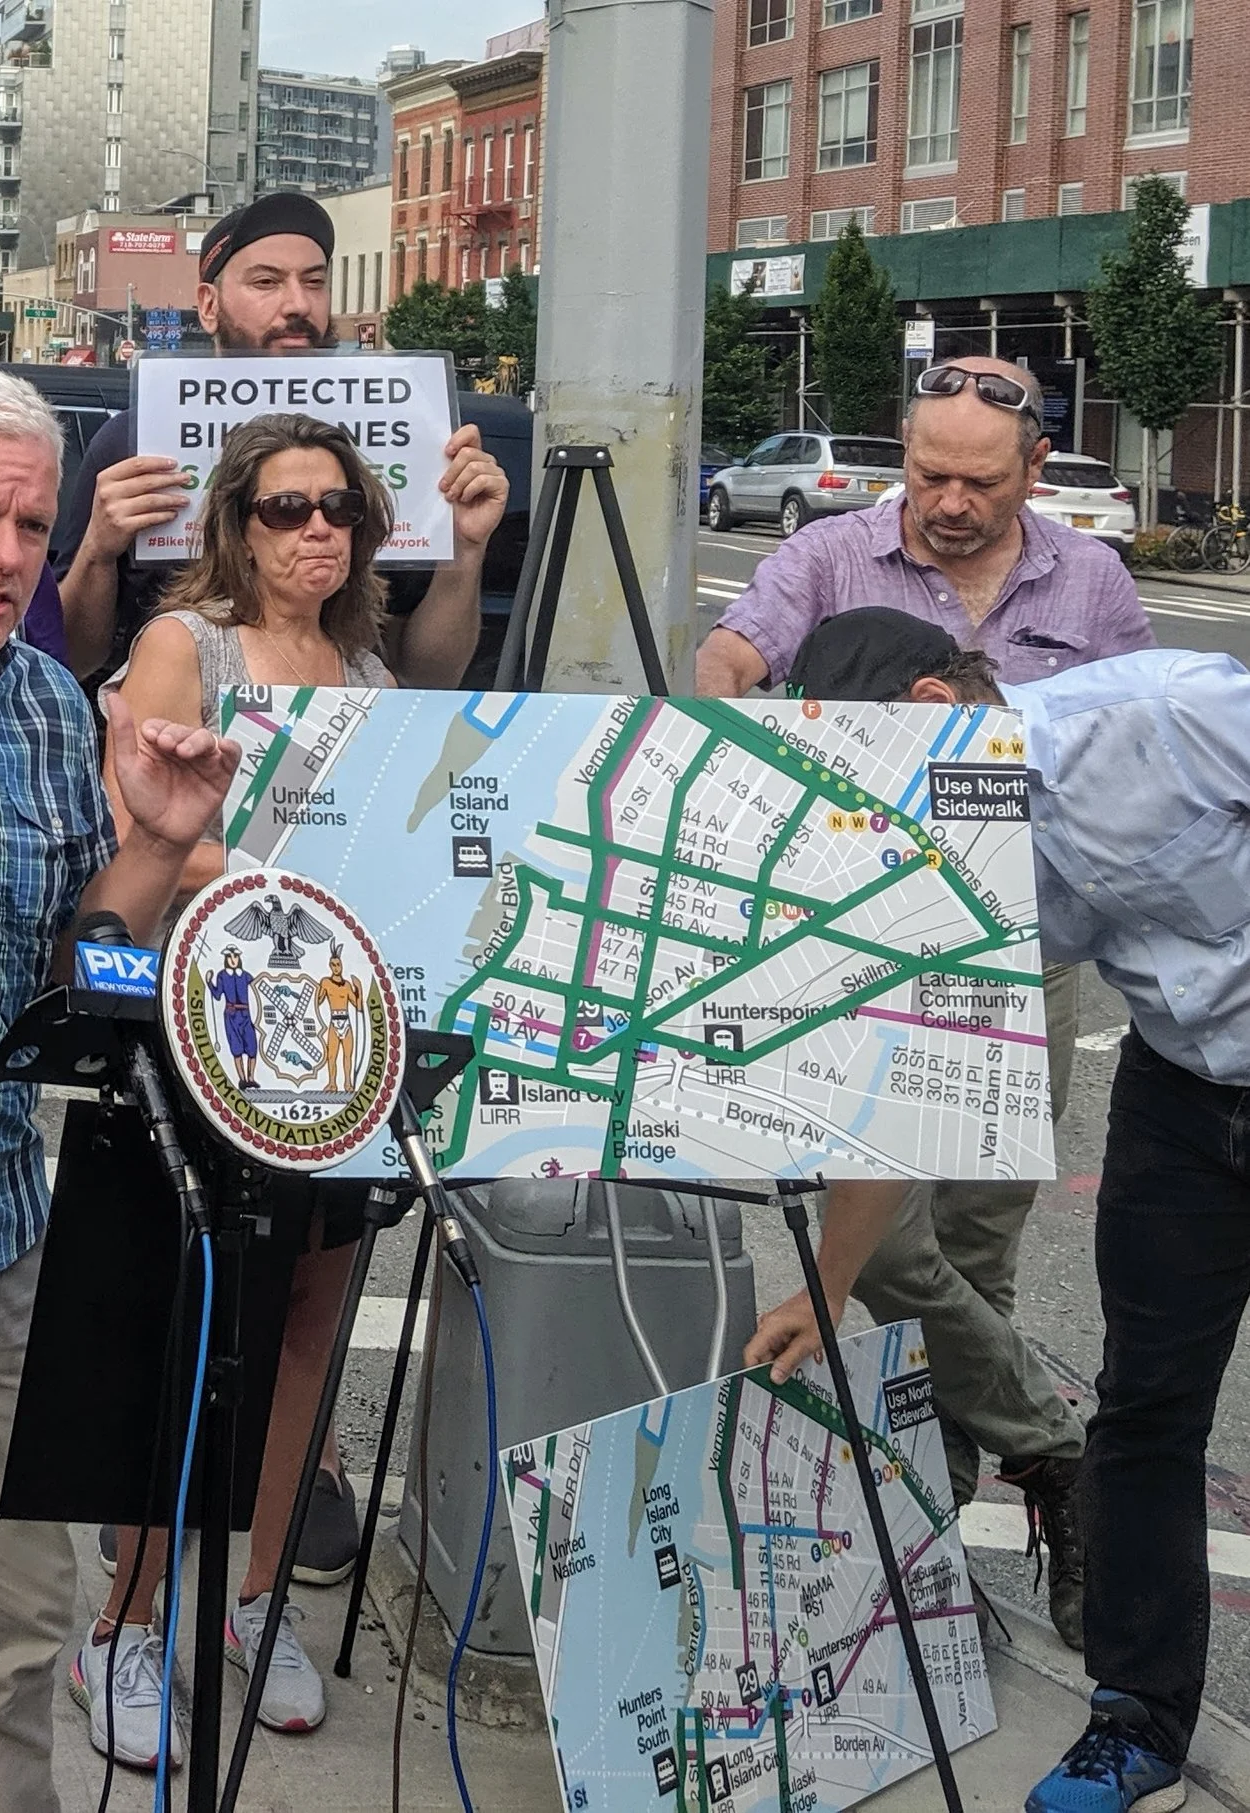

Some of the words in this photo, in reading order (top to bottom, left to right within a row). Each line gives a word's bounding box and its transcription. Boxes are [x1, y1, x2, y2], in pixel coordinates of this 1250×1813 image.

[147, 330, 163, 339] 495
[165, 330, 181, 340] 495
[179, 377, 411, 405] PROTECTED
[344, 420, 411, 447] NES
[834, 714, 853, 733] 41
[851, 727, 876, 747] Av
[303, 730, 338, 774] FDR
[574, 726, 619, 786] Vernon
[642, 747, 663, 768] 43
[713, 737, 732, 759] St
[762, 714, 828, 764] Queens
[830, 754, 860, 783] Plz
[449, 772, 498, 793] Long
[935, 777, 973, 795] Use
[978, 778, 1029, 796] North
[272, 787, 334, 805] United
[450, 793, 509, 811] Island
[620, 806, 639, 825] 10
[631, 785, 652, 807] St
[727, 779, 750, 800] 43
[749, 794, 773, 815] Av
[273, 808, 347, 826] Nations
[937, 799, 1024, 818] Sidewalk
[450, 813, 490, 834] City
[705, 814, 729, 834] Av
[794, 823, 814, 845] St
[703, 834, 729, 856] Rd
[700, 853, 723, 872] Dr
[693, 879, 717, 898] Av
[930, 825, 982, 892] Queens
[979, 889, 1016, 932] Blvd
[472, 913, 512, 971] Center
[496, 862, 518, 907] Blvd
[691, 900, 718, 920] Rd
[674, 961, 697, 985] Av
[94, 980, 115, 991] NEW
[492, 991, 516, 1011] 50
[520, 999, 546, 1020] Av
[919, 990, 1028, 1011] Community
[921, 1011, 992, 1032] College
[892, 1045, 909, 1066] St
[909, 1048, 926, 1069] St
[986, 1041, 1004, 1063] St
[190, 997, 235, 1098] SIGILLUM
[235, 1098, 333, 1144] CIVITATIS
[337, 1094, 371, 1132] NOVI
[368, 1005, 386, 1092] EBORACI
[705, 1069, 746, 1085] LIRR
[797, 1060, 820, 1079] 49
[824, 1068, 848, 1087] Av
[945, 1058, 962, 1080] St
[891, 1072, 907, 1095] 29
[907, 1074, 924, 1098] 30
[927, 1077, 943, 1101] 30
[1025, 1071, 1041, 1091] St
[521, 1084, 580, 1103] Island
[943, 1083, 960, 1105] 31
[965, 1088, 982, 1109] 31
[982, 1071, 1002, 1116] Dam
[1005, 1093, 1022, 1116] 32
[280, 1106, 322, 1121] 1625
[480, 1109, 521, 1125] LIRR
[1023, 1096, 1039, 1119] 33
[612, 1120, 680, 1138] Pulaski
[726, 1102, 796, 1136] Borden
[800, 1123, 826, 1143] Av
[613, 1141, 676, 1162] Bridge
[980, 1121, 998, 1159] Van
[796, 1368, 833, 1403] Queens
[887, 1393, 907, 1409] Use
[891, 1401, 936, 1429] Sidewalk
[708, 1411, 726, 1471] Vernon
[891, 1438, 925, 1490] Queens
[561, 1476, 577, 1521] FDR
[642, 1483, 672, 1505] Long
[528, 1503, 542, 1530] Av
[646, 1498, 680, 1525] Island
[549, 1531, 587, 1560] United
[650, 1525, 673, 1544] City
[552, 1554, 596, 1582] Nations
[906, 1555, 952, 1587] LaGuardia
[801, 1575, 835, 1601] MoMA
[909, 1571, 961, 1604] Community
[805, 1599, 825, 1620] PS1
[739, 1667, 758, 1695] 29
[618, 1687, 663, 1718] Hunters
[636, 1704, 667, 1733] Point
[637, 1728, 670, 1755] South
[834, 1735, 871, 1752] Borden
[873, 1736, 886, 1751] Av
[726, 1746, 754, 1769] Long
[730, 1766, 762, 1791] Island
